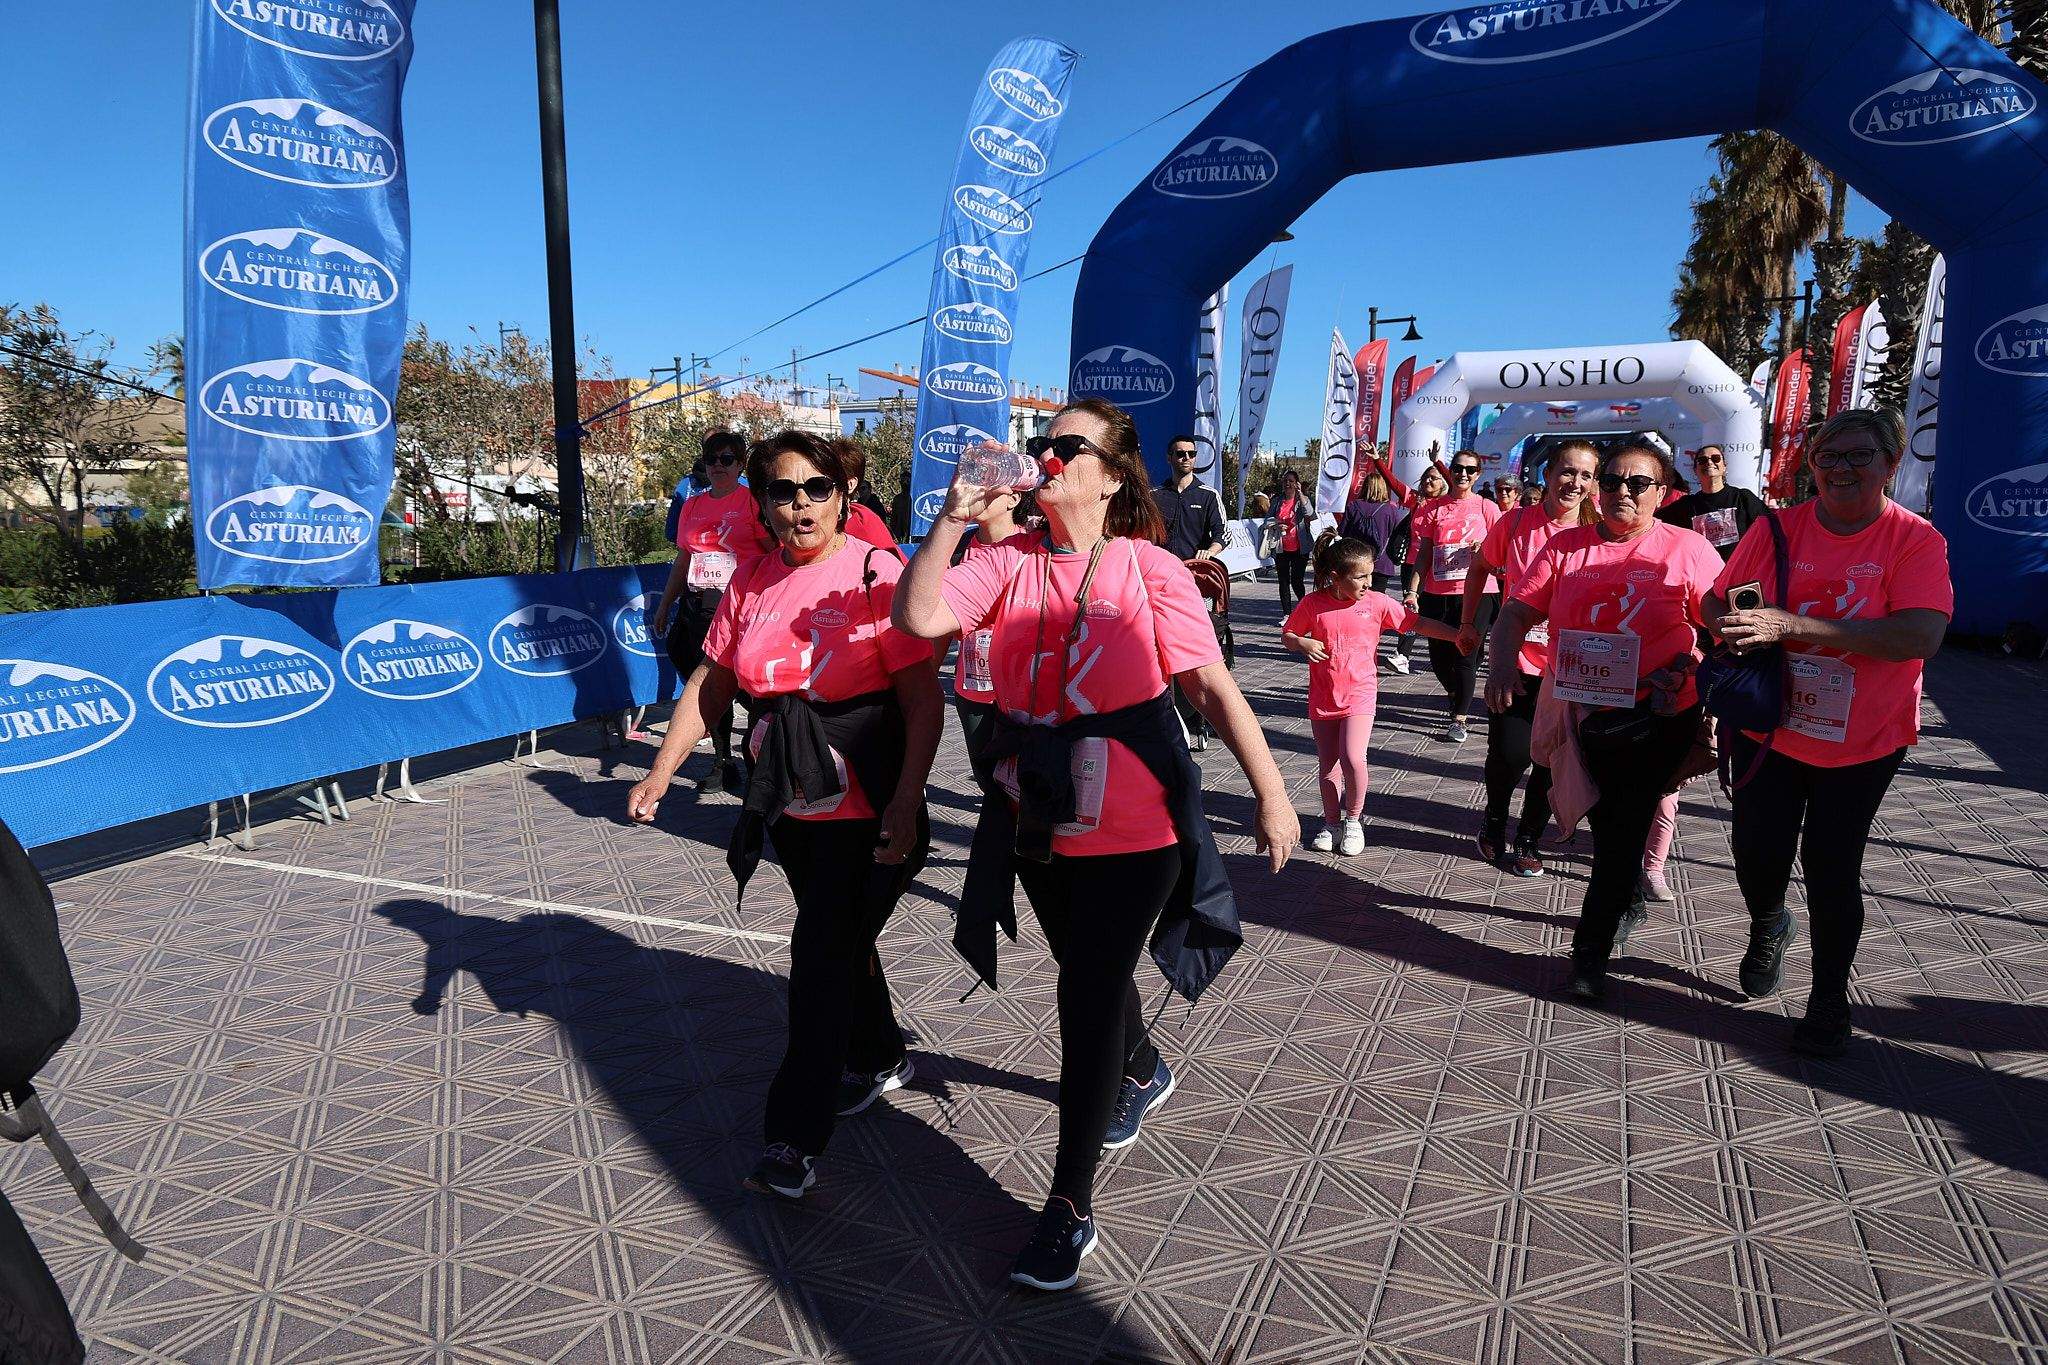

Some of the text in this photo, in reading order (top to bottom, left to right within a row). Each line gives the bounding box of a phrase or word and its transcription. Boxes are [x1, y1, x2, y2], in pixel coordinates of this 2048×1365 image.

[226, 0, 391, 46] ASTURIANA
[328, 3, 387, 21] LECHERA
[1428, 0, 1670, 46] ASTURIAN
[1892, 92, 1954, 108] CENTRAL
[1862, 95, 2027, 134] ASTURIANA
[218, 117, 388, 176] ASTURIANA
[251, 119, 383, 151] CENTRAL LECHERA
[974, 131, 1039, 173] ASTURIANA
[1159, 164, 1268, 187] ASTURIANA
[214, 249, 384, 302] ASTURIANA
[246, 250, 378, 277] CENTRAL LECHERA
[939, 312, 1008, 341] ASTURIANA
[1074, 369, 1167, 393] ASTURIANA
[1499, 356, 1645, 389] OYSHO
[1837, 328, 1860, 413] Santander
[1910, 273, 1946, 462] OYSH
[246, 384, 373, 403] CENTRAL LECHERA
[931, 373, 1003, 397] ASTURIANA
[1359, 360, 1377, 432] Santander
[1688, 383, 1735, 395] OYSHO
[215, 383, 379, 427] ASTURIANA
[1417, 395, 1458, 405] OYSHO
[1783, 367, 1801, 432] Santander
[925, 436, 967, 455] ASTUR
[1720, 442, 1755, 453] YSHO
[2003, 487, 2048, 497] CENTR
[220, 512, 363, 545] ASTURIANA
[249, 511, 310, 522] CENTRAL
[703, 570, 722, 578] 016
[371, 640, 463, 658] CENTRAL LECHERA
[501, 632, 602, 664] ASTURIANA
[188, 658, 310, 681] CENTRAL LECHERA
[356, 651, 477, 685] ASTURIANA
[1580, 663, 1611, 678] 016
[24, 683, 102, 704] LECHERA
[168, 668, 328, 714] ASTURIANA
[1793, 690, 1818, 706] 16
[0, 697, 124, 743] URIANA
